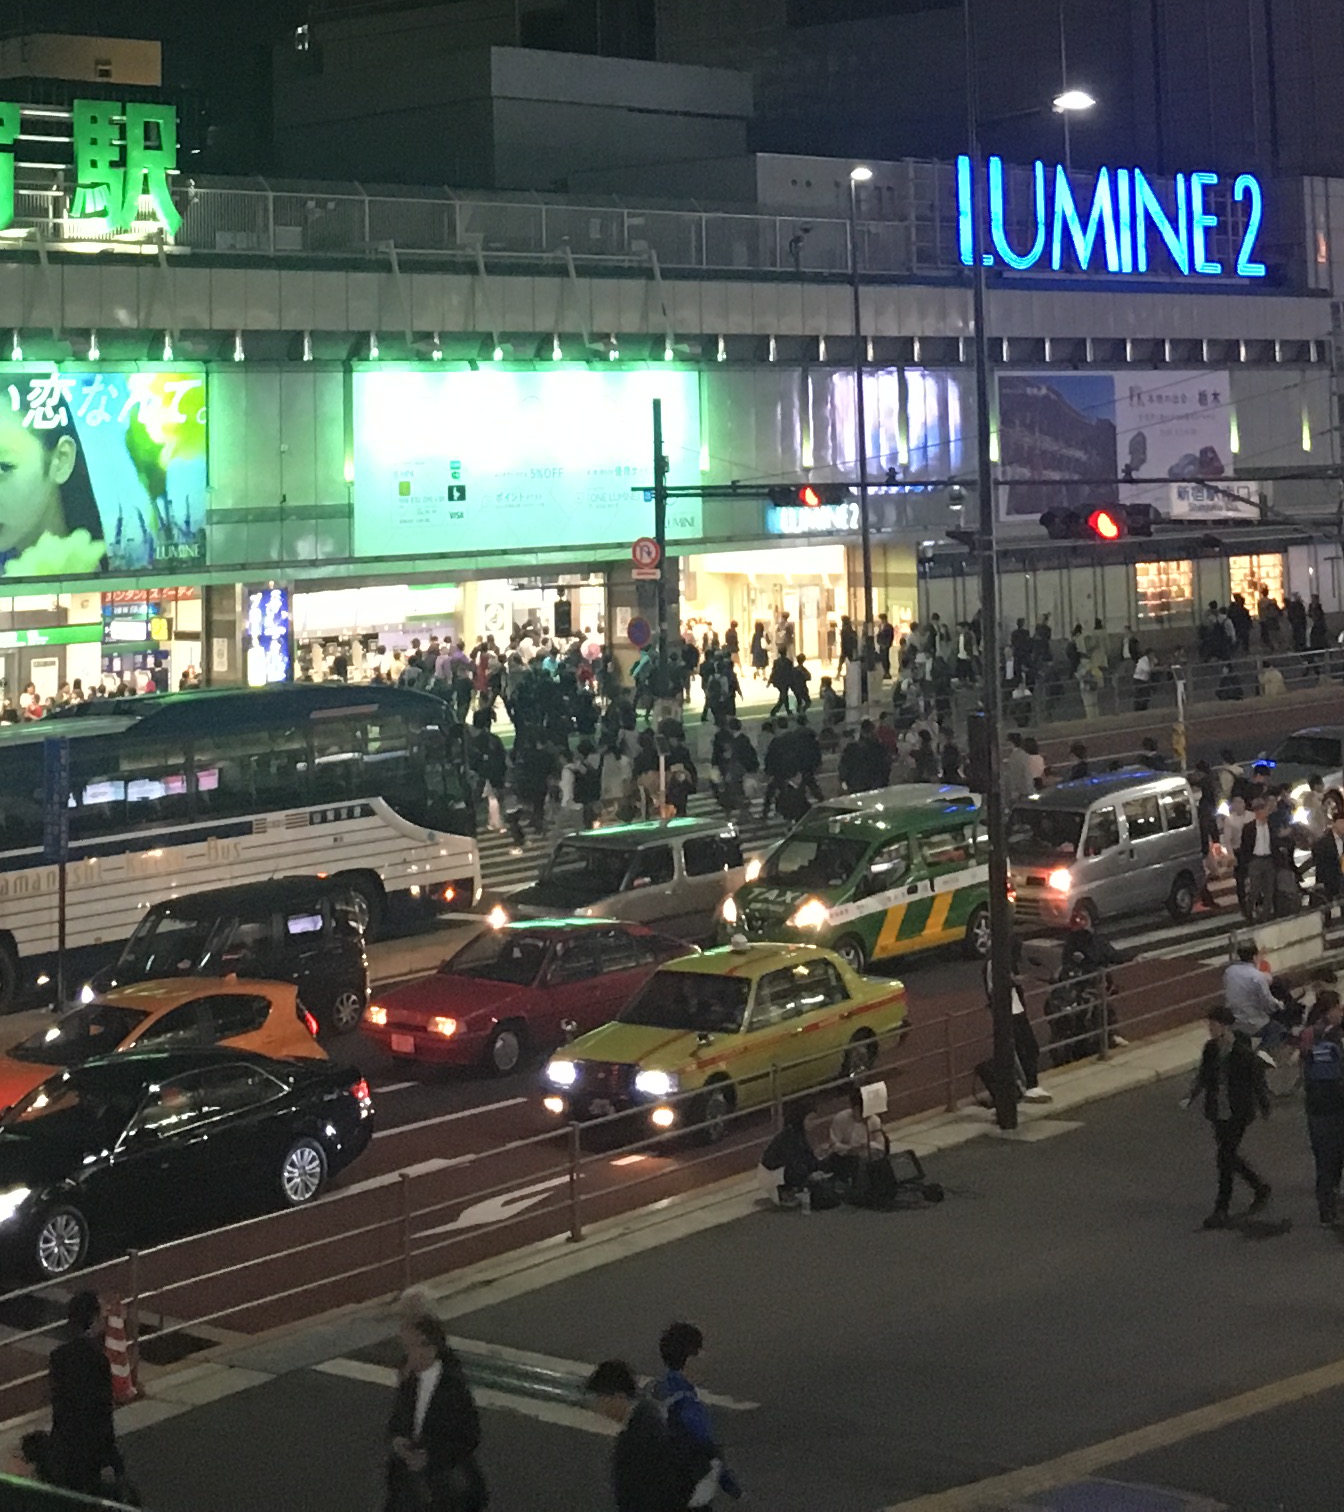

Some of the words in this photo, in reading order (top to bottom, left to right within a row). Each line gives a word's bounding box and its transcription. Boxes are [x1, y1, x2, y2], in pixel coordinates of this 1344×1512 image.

[957, 153, 1222, 276] LUMINE
[1233, 173, 1267, 276] 2
[780, 504, 849, 534] LUMINE
[156, 544, 200, 560] LUMINE
[207, 836, 242, 862] Bus
[747, 888, 809, 905] TAXI
